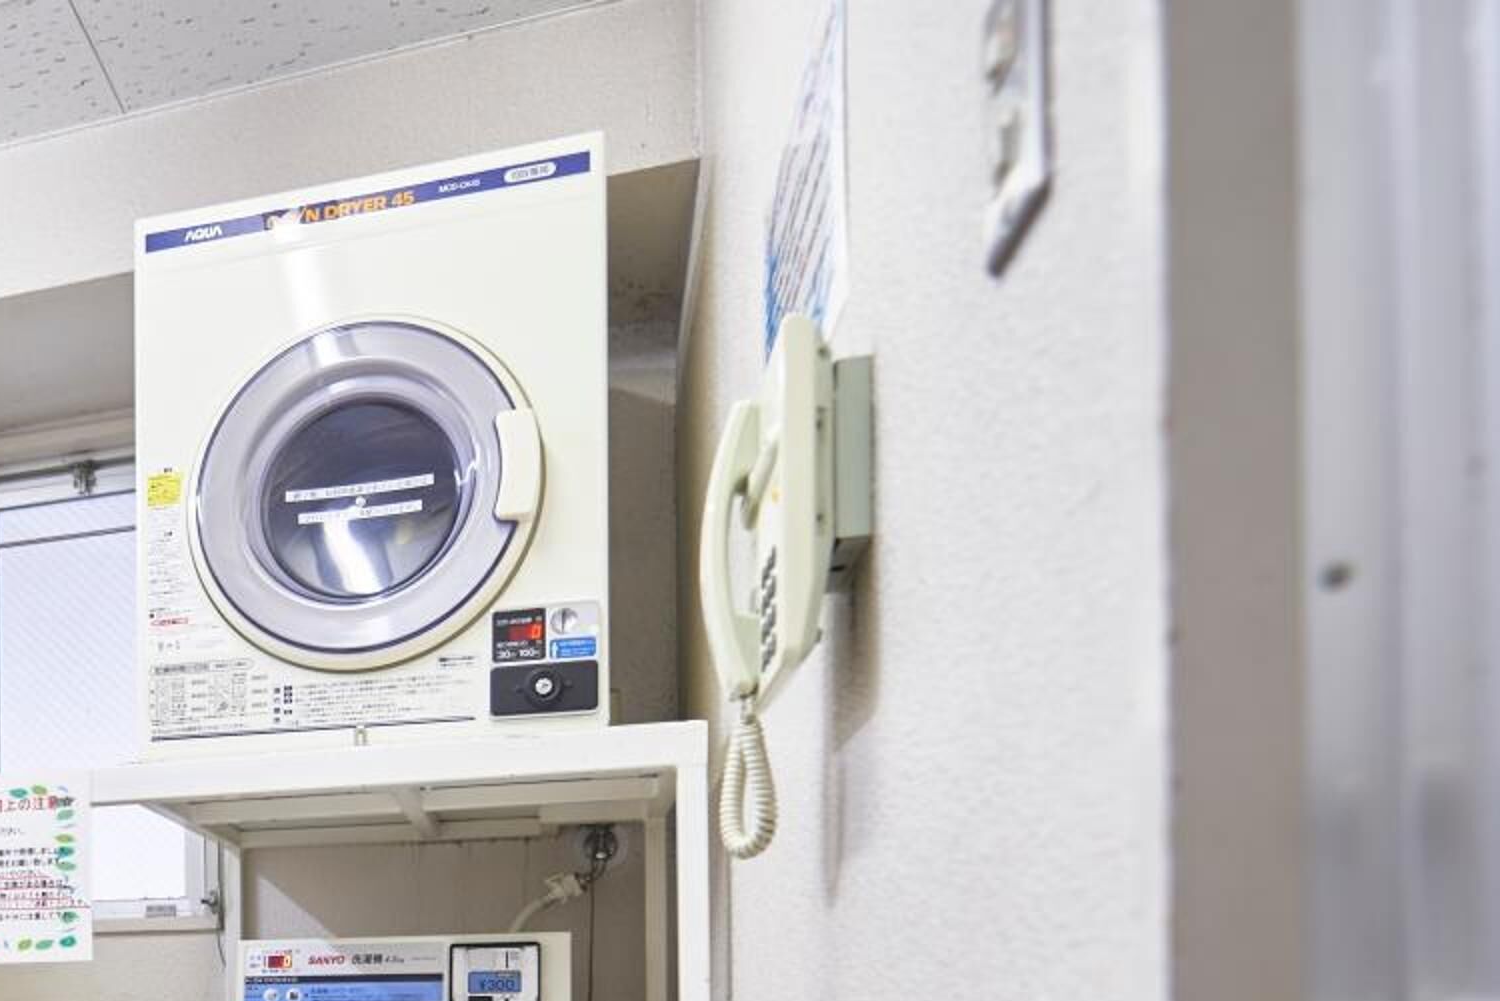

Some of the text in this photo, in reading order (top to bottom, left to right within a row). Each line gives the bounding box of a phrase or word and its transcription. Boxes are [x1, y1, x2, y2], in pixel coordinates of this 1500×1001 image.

[184, 225, 223, 242] AQUA
[324, 194, 387, 219] DRYER
[392, 190, 415, 207] 45
[308, 955, 345, 965] SANYO
